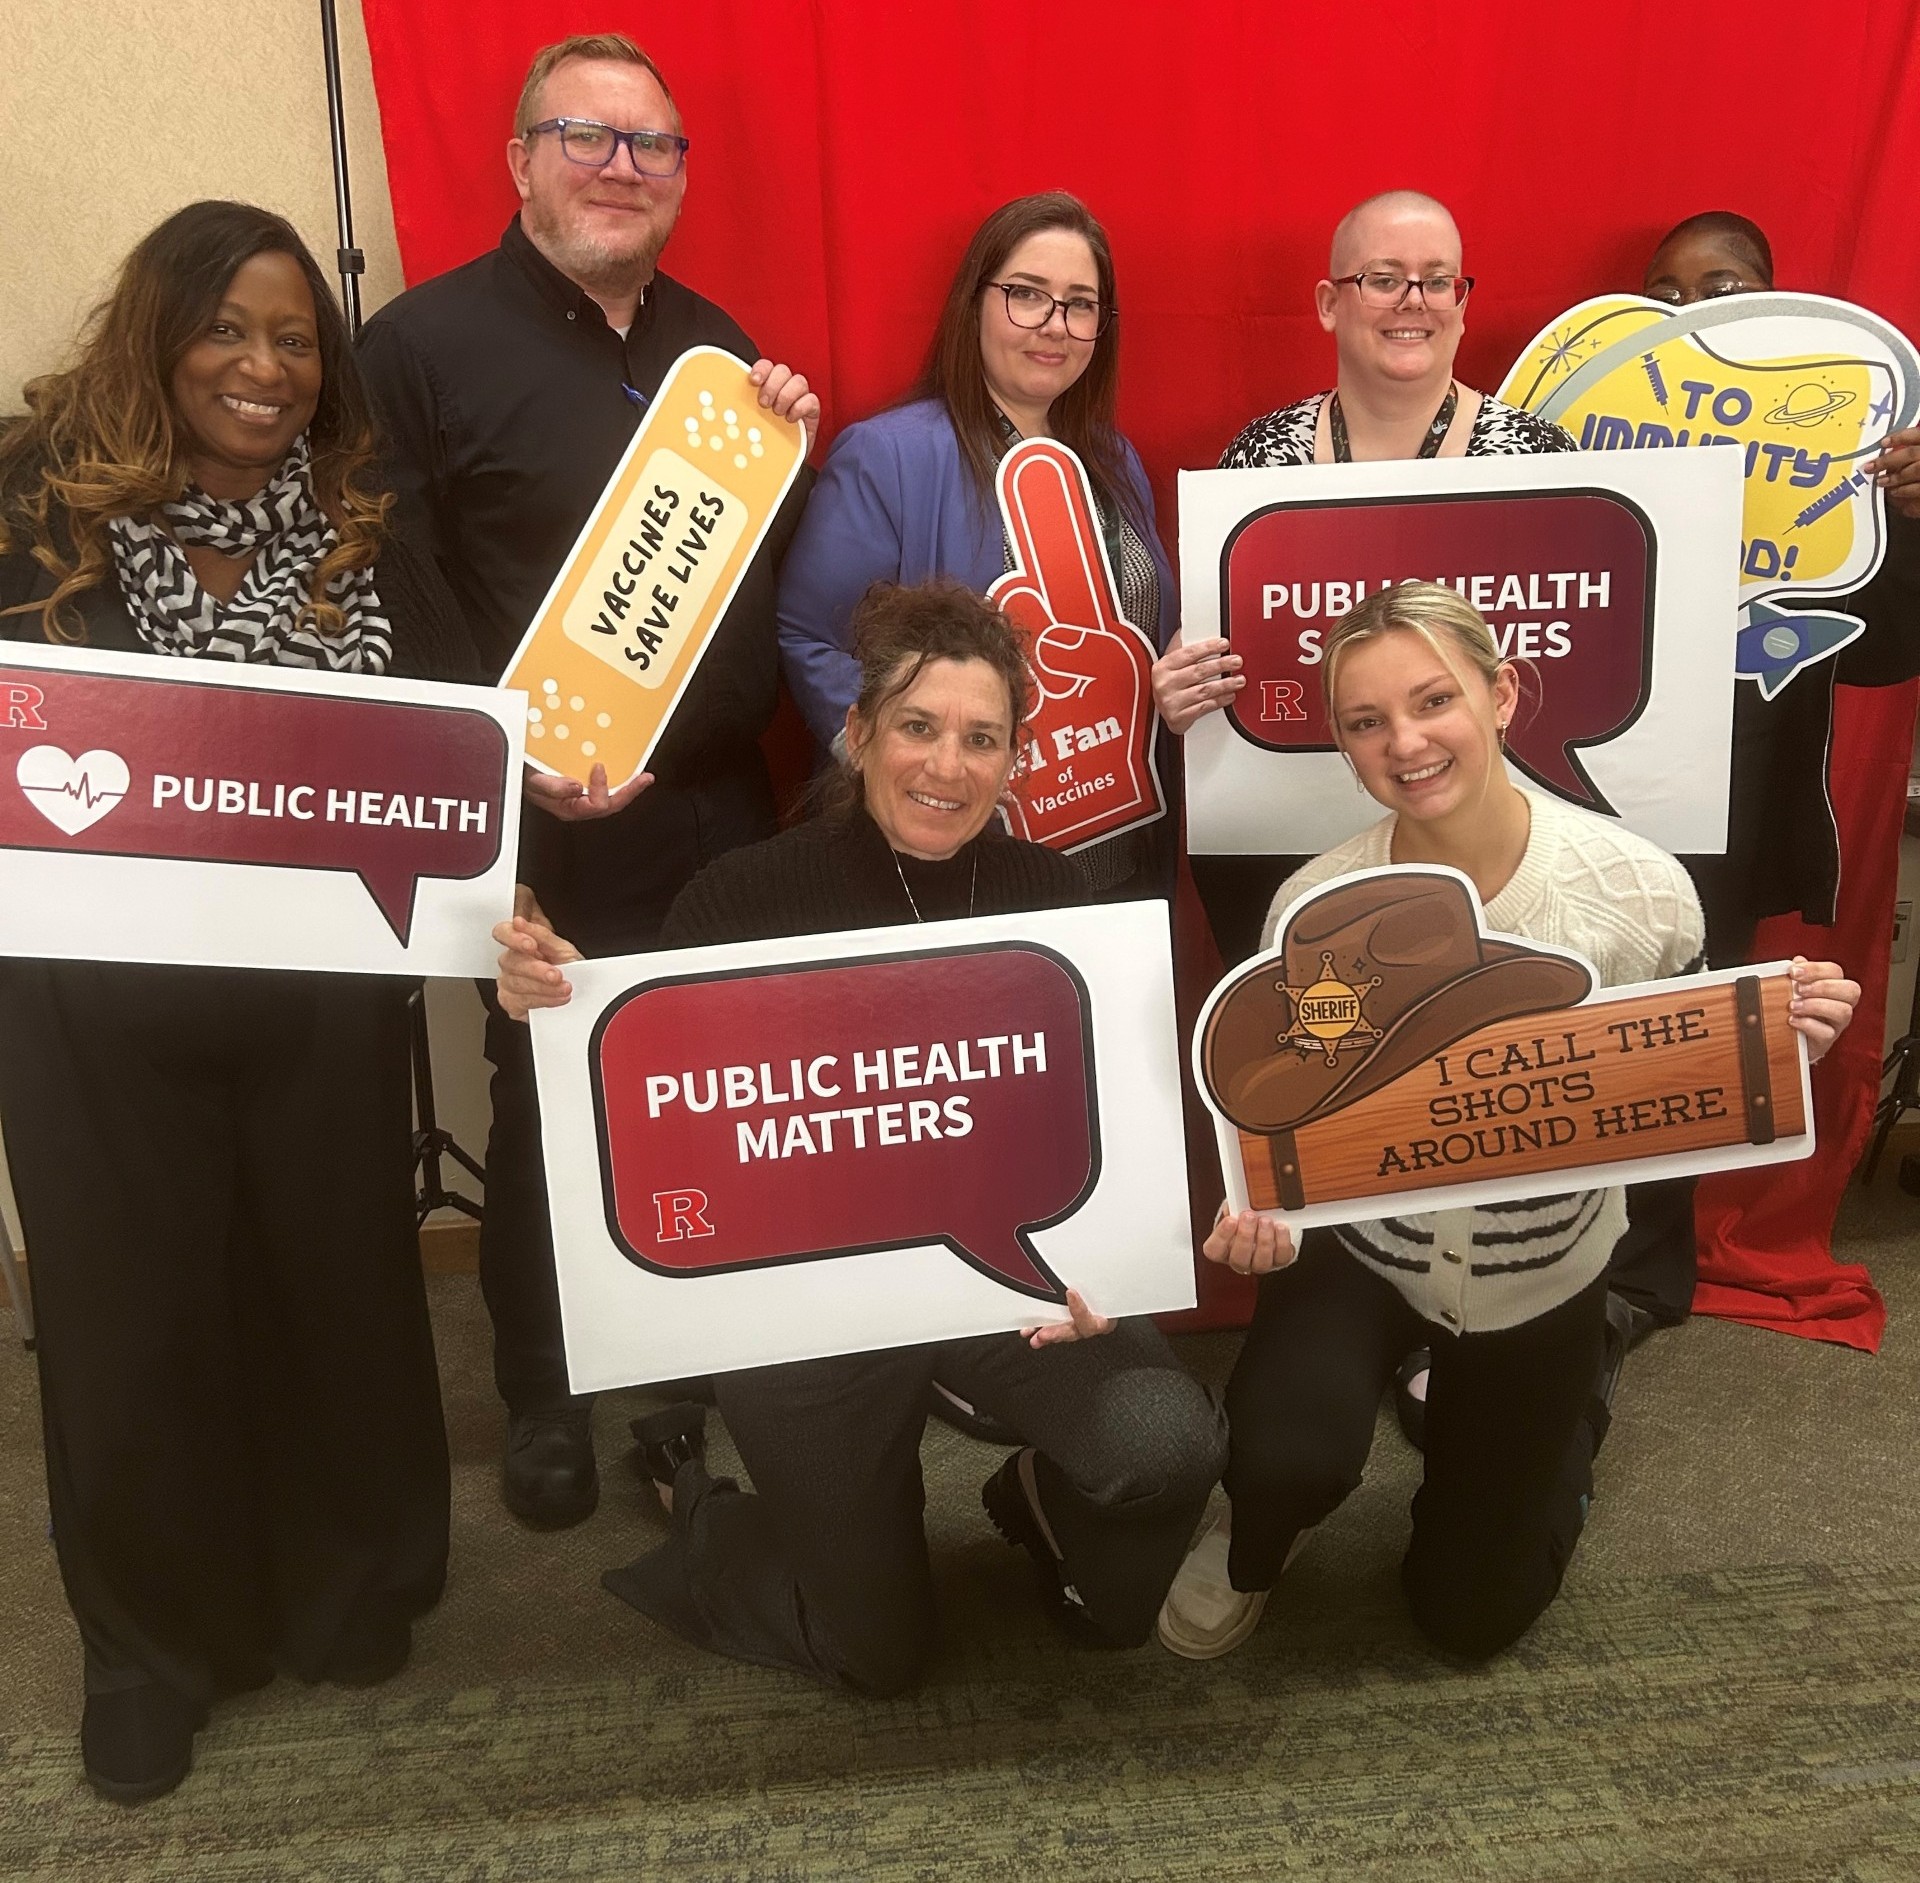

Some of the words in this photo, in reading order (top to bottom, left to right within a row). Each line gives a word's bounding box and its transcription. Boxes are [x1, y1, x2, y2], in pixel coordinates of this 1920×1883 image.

[1680, 380, 1753, 427] TO
[1580, 413, 1832, 488] IMMITY
[591, 484, 680, 636] VACCINES
[624, 584, 679, 672] SAVE
[667, 491, 725, 584] LIVES
[1260, 680, 1308, 722] R
[1051, 715, 1123, 761] Fan
[1031, 771, 1116, 815] Vaccines
[1057, 765, 1073, 784] of
[152, 774, 316, 820] PUBLIC
[326, 788, 488, 834] HEALTH
[1301, 999, 1357, 1021] SHERIFF
[645, 1055, 842, 1119] PUBLIC
[853, 1031, 1047, 1094] HEALTH
[1435, 1056, 1453, 1087] I
[1466, 1032, 1596, 1080] CALL
[1607, 1008, 1709, 1053] THE
[1429, 1070, 1595, 1127] SHOTS
[736, 1095, 974, 1164] MATTERS
[1376, 1115, 1577, 1177] AROUND
[1591, 1087, 1728, 1139] HERE
[652, 1188, 715, 1243] R
